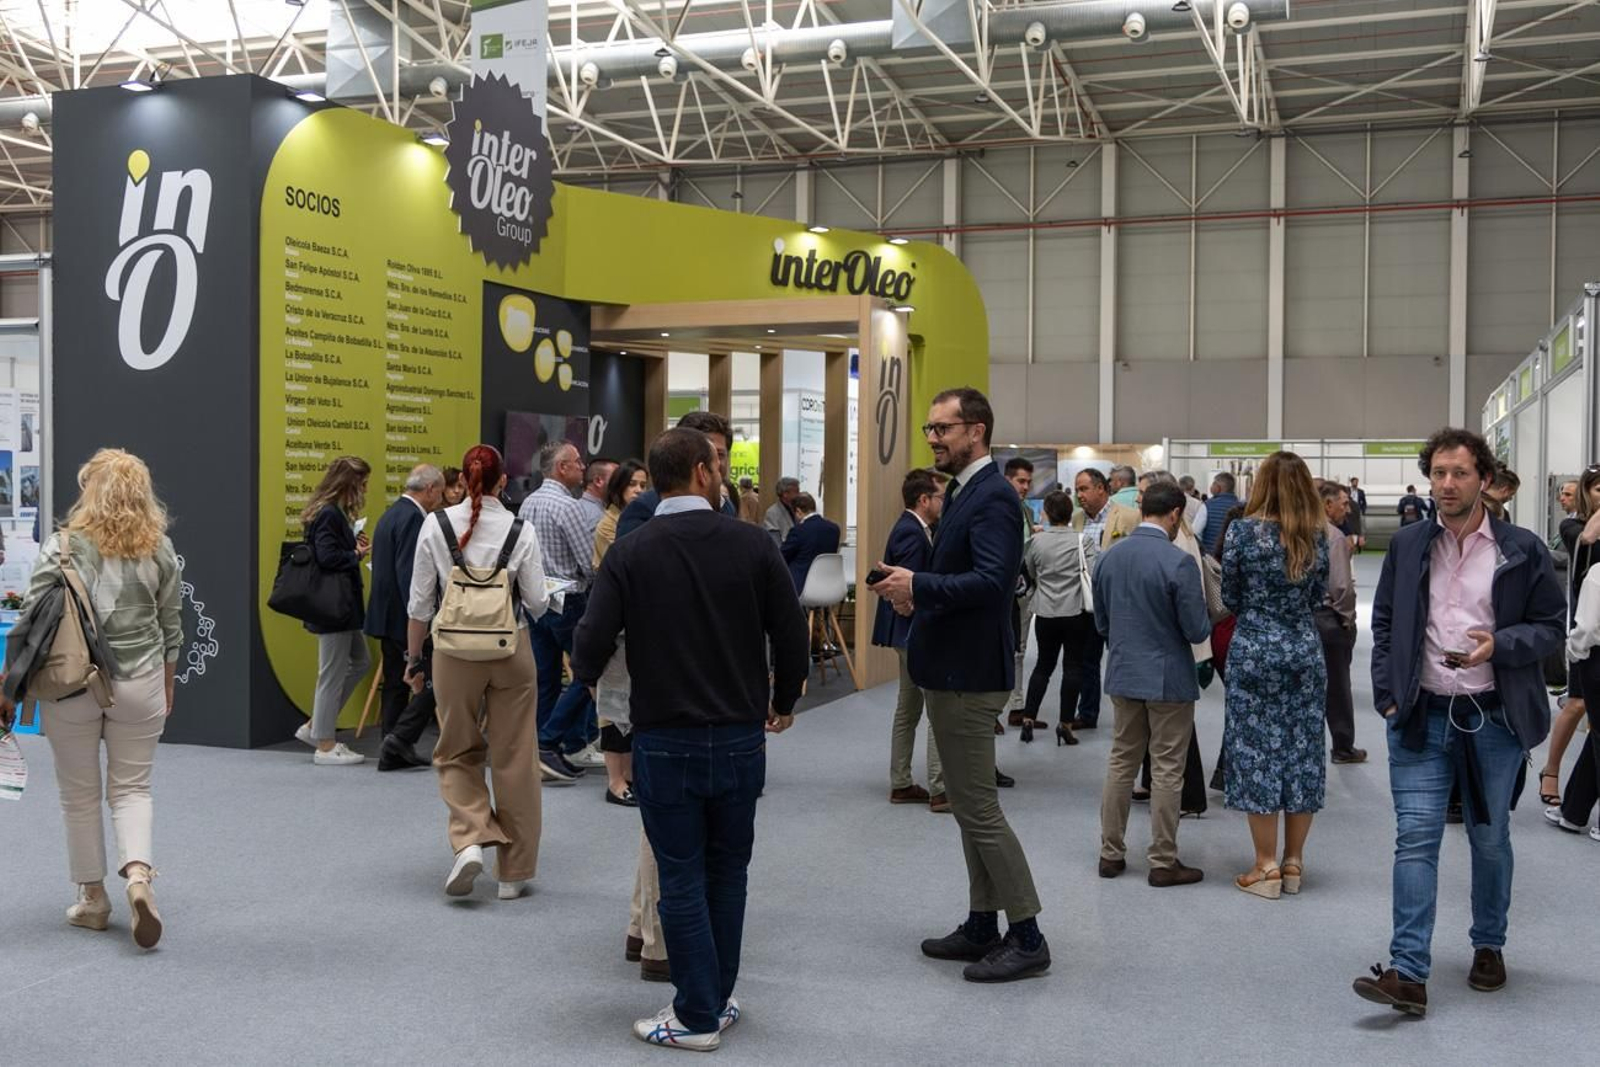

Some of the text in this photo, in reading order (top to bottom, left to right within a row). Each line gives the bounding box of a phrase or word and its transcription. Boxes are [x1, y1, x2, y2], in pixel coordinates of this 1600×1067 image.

[471, 119, 537, 179] inter
[467, 155, 533, 221] Oleo
[285, 186, 341, 218] SOCIOS
[496, 216, 532, 246] Group
[312, 241, 330, 255] Baeza
[332, 246, 349, 258] S.C.A.
[285, 258, 298, 269] San
[299, 261, 318, 274] Felipe
[342, 270, 360, 282] S.C.A.
[770, 238, 916, 301] interOleo
[285, 280, 324, 297] Bedmarense
[325, 287, 343, 301] S.C.A.
[285, 304, 365, 325] Cristo de la Veracruz S.C.A.
[387, 300, 397, 310] San
[285, 326, 308, 339] Aceites
[337, 334, 345, 344] de
[345, 335, 372, 348] Bobadilla
[373, 338, 384, 349] S.L.
[285, 348, 294, 359] La
[294, 350, 323, 363] Bobadilla
[324, 353, 343, 365] S.C.A.
[285, 371, 294, 381] La
[314, 375, 322, 384] de
[323, 375, 352, 388] Bujalance
[352, 378, 370, 389] S.C.A.
[285, 394, 306, 406] Virgen
[306, 396, 316, 406] del
[332, 398, 343, 408] S.L.
[353, 420, 371, 430] S.C.A.
[285, 439, 343, 450] Aceituna Verde S.L.
[285, 461, 298, 472] San
[298, 462, 316, 472] Isidro
[285, 484, 314, 493] Ntra. Sra.
